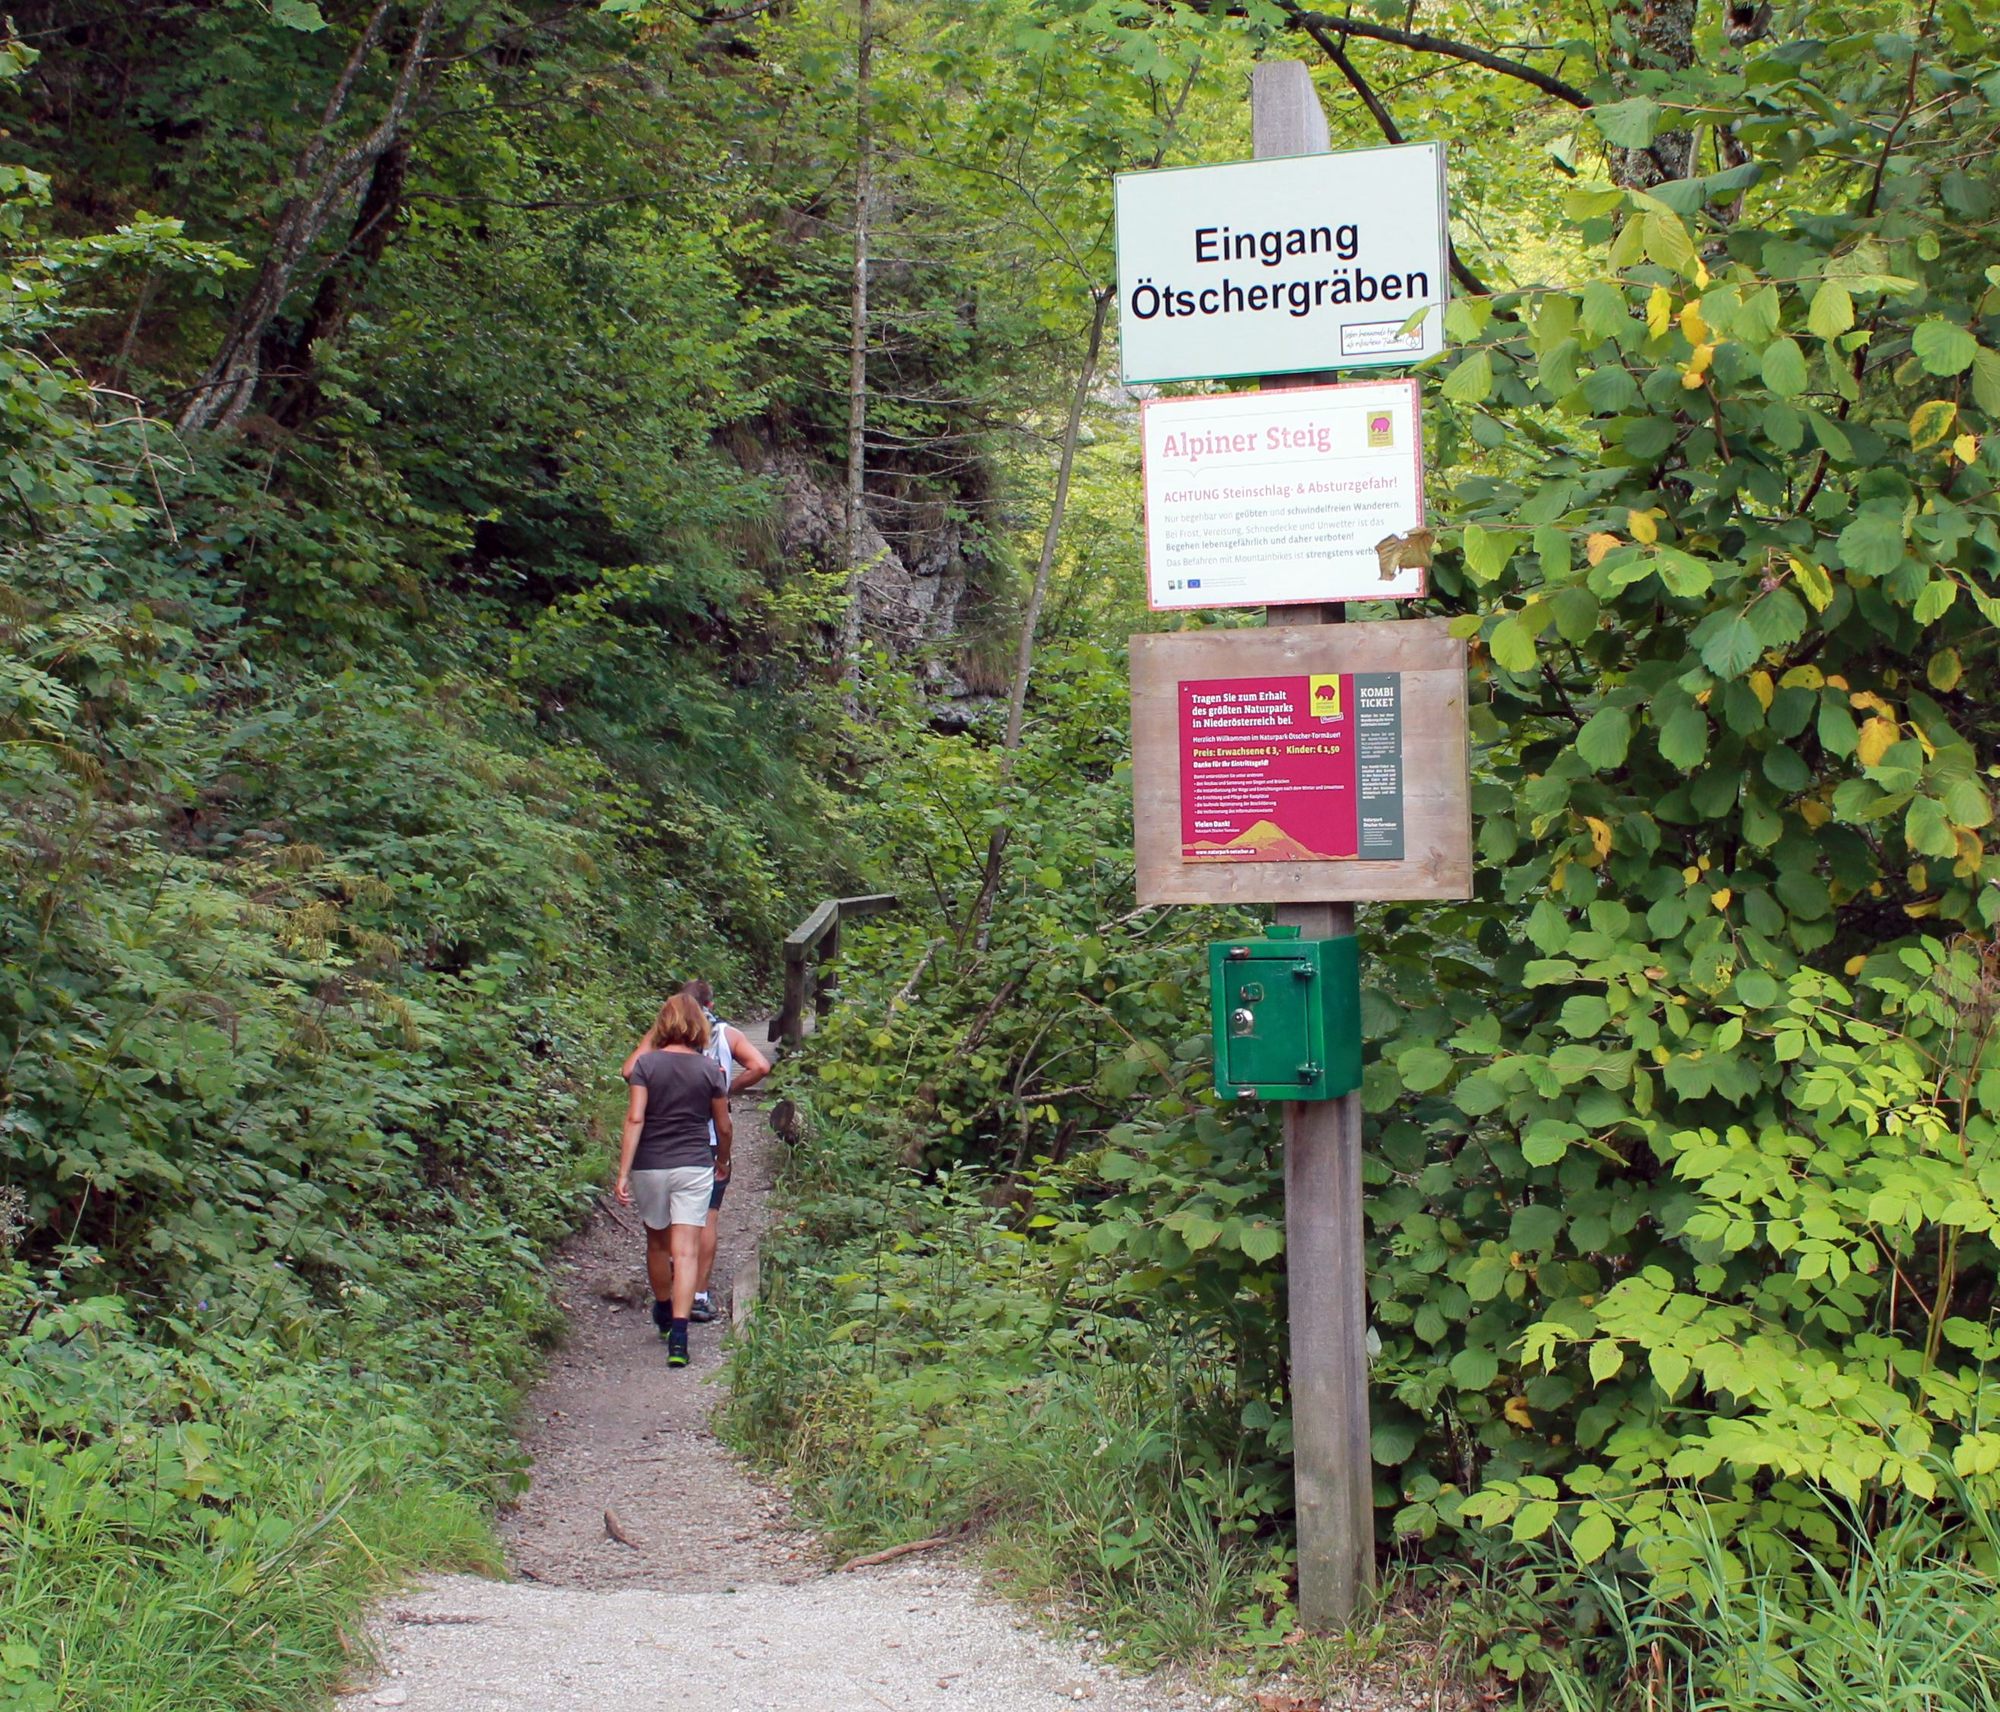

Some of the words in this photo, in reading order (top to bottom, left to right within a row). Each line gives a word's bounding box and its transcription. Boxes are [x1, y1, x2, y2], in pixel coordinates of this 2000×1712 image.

[1195, 224, 1358, 266] Eingang
[1131, 268, 1428, 318] Ötschergräben
[1162, 430, 1257, 462] Alpiner
[1266, 422, 1331, 452] Steig
[1164, 489, 1220, 503] ACHTUNG
[1296, 483, 1304, 494] &
[1308, 476, 1398, 493] Absturzgefahr!
[1164, 515, 1178, 523] Nur
[1181, 512, 1216, 524] begehbar
[1220, 512, 1233, 520] von
[1235, 510, 1268, 520] geübten
[1270, 508, 1285, 516] und
[1288, 504, 1351, 516] schwindelfreien
[1166, 530, 1178, 538] Bei
[1246, 523, 1296, 534] Schneedecke
[1300, 522, 1314, 530] und
[1318, 520, 1355, 530] Unwetter
[1358, 519, 1368, 527] ist
[1370, 518, 1384, 526] das
[1166, 542, 1200, 552] Begehen
[1202, 537, 1268, 550] lebensgefährlich
[1270, 536, 1286, 544] und
[1288, 535, 1312, 544] daher
[1314, 532, 1354, 542] verboten!
[1166, 558, 1180, 567] Das
[1183, 557, 1218, 566] Befahren
[1220, 555, 1232, 564] mit
[1235, 552, 1292, 563] Mountainbikes
[1306, 549, 1354, 559] strengstens
[1192, 694, 1222, 705] Tragen
[1224, 694, 1236, 702] Sie
[1259, 691, 1286, 700] Erhalt
[1360, 687, 1394, 698] KOMBI
[1192, 706, 1207, 716] des
[1208, 704, 1242, 717] größten
[1244, 703, 1294, 714] Naturparks
[1360, 698, 1394, 708] TICKET
[1192, 718, 1202, 728] in
[1204, 716, 1276, 728] Niederösterreich
[1278, 716, 1294, 724] bei.
[1260, 734, 1288, 742] Naturpark
[1194, 748, 1216, 757] Preis:
[1217, 747, 1264, 756] Erwachsene
[1286, 744, 1316, 754] Kinder:
